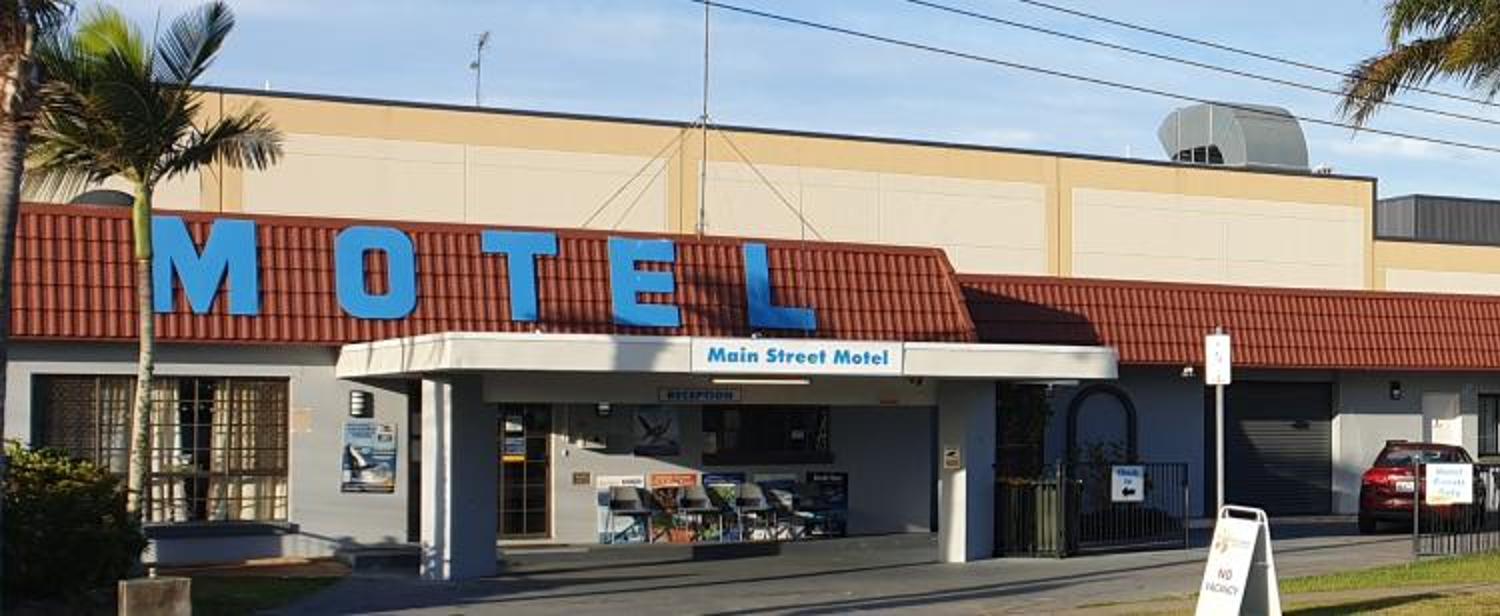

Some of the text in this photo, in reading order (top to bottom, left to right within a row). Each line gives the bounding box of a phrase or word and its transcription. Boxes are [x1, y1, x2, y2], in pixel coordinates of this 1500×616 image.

[152, 215, 817, 331] MOTEL
[707, 347, 889, 365] Main Street Motel
[667, 390, 733, 401] RECEPTION
[1217, 567, 1233, 581] NO
[1205, 581, 1239, 596] VACANCY
